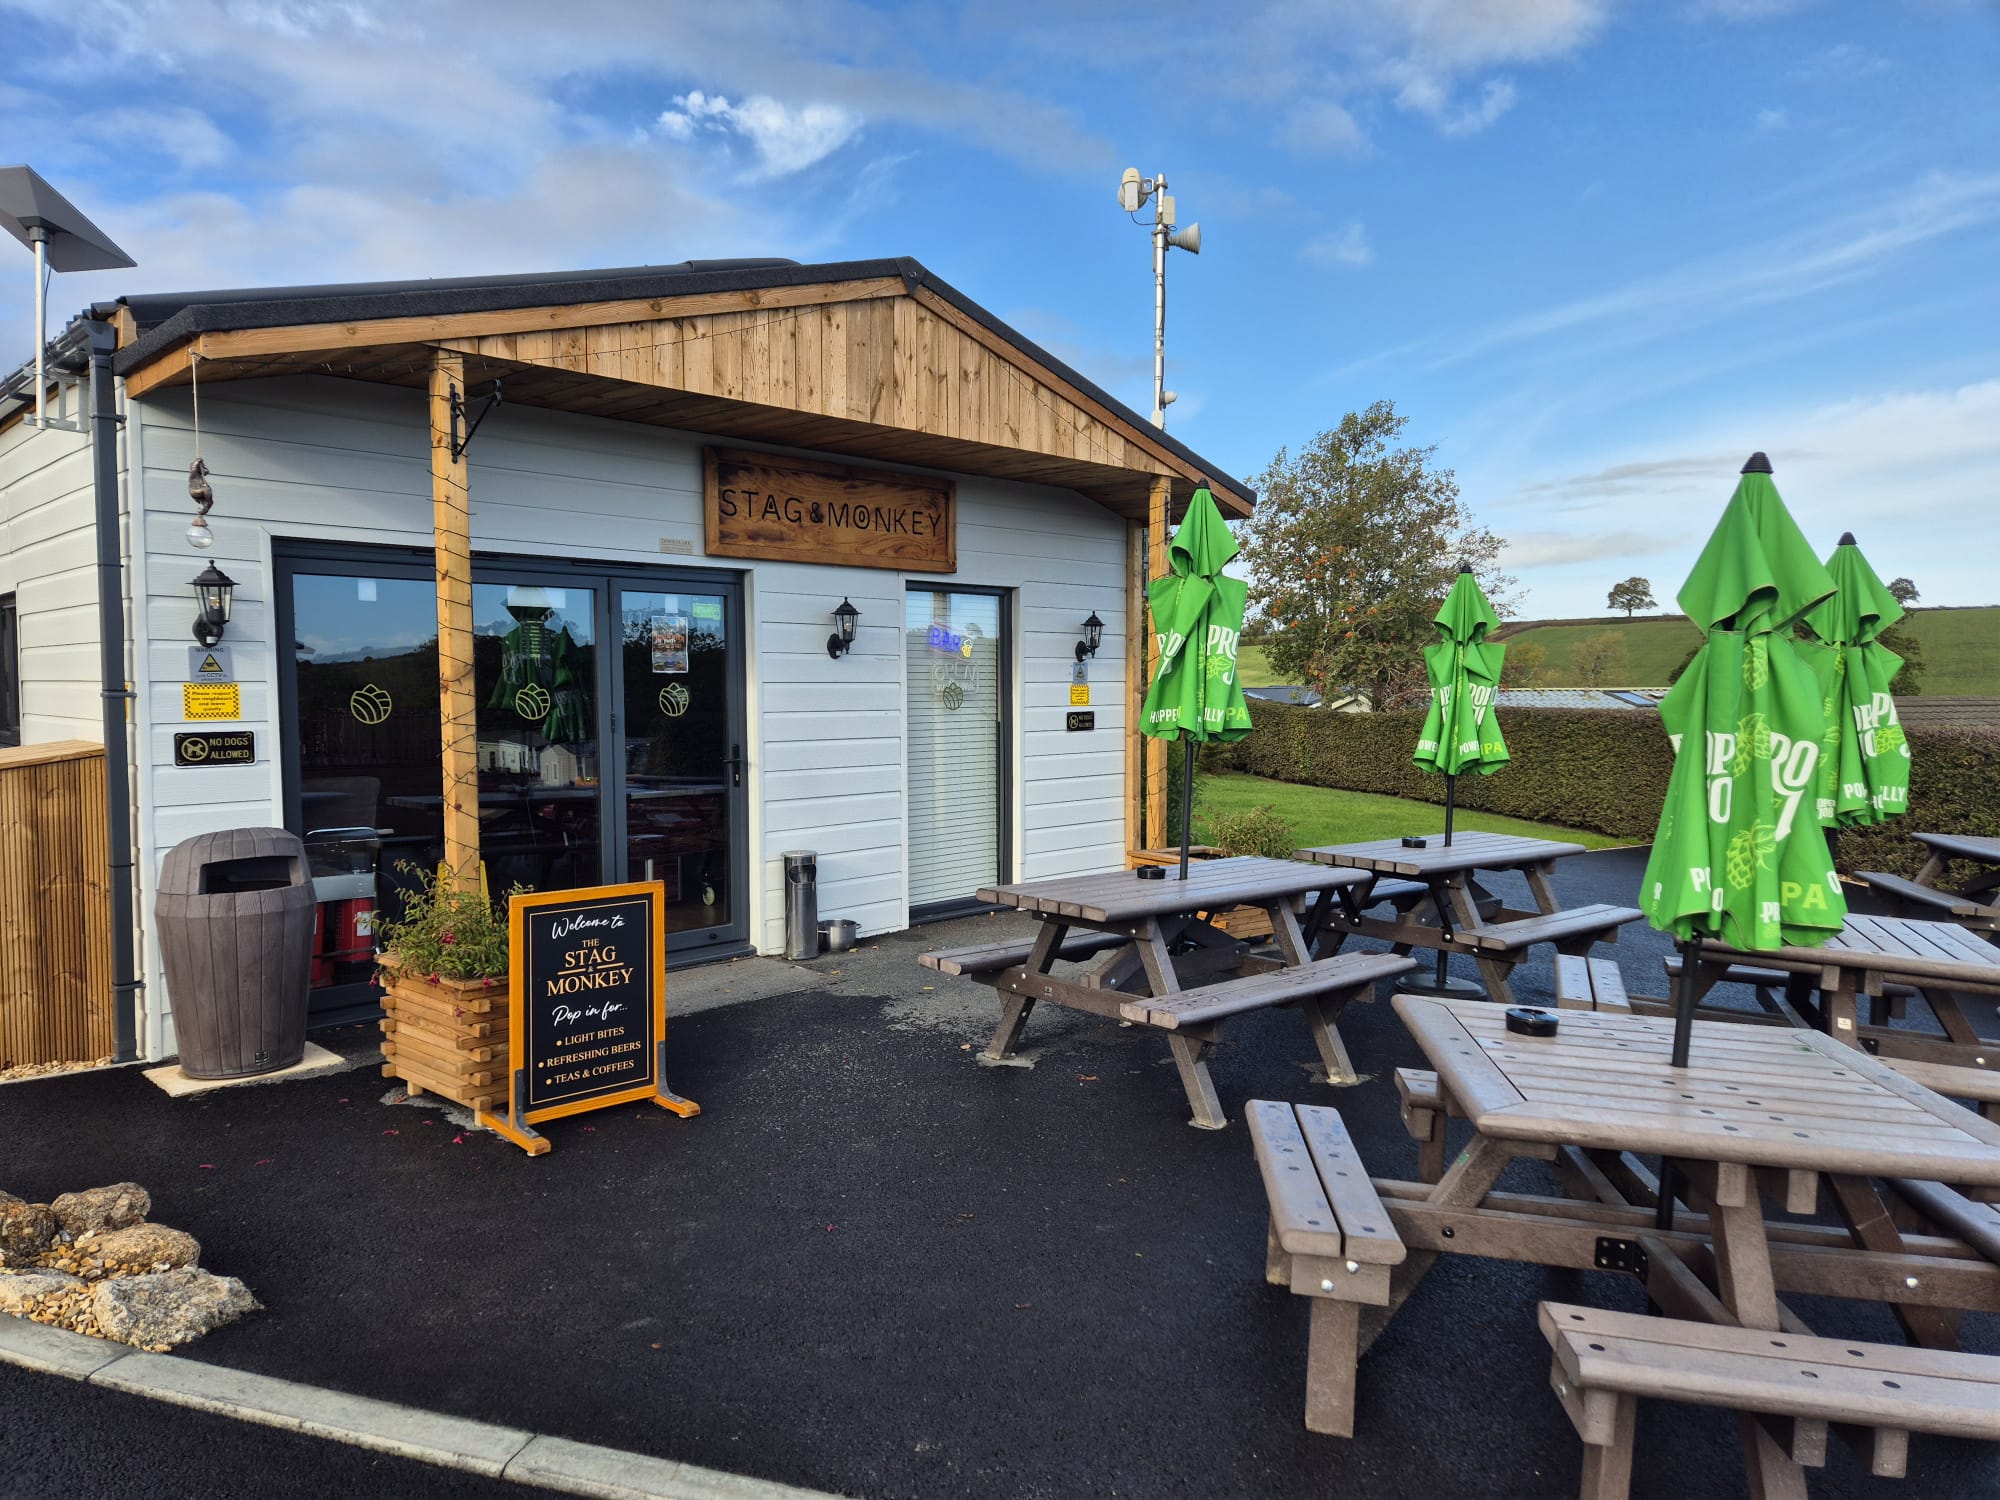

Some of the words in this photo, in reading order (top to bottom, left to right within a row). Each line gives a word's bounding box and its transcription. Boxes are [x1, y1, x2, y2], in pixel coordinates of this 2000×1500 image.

[930, 627, 961, 653] BAR
[209, 738, 222, 747] NO
[224, 737, 249, 746] DOGS
[210, 750, 250, 759] ALLOWED
[551, 914, 609, 940] Welcome
[610, 914, 625, 929] to
[581, 938, 600, 948] THE
[565, 946, 617, 968] STAG
[546, 967, 634, 997] MONKEY
[551, 1005, 581, 1027] Pop
[585, 1004, 600, 1017] in
[565, 1031, 595, 1046] LIGHT
[597, 1026, 625, 1039] BITES
[546, 1047, 609, 1068] REFRESHING
[611, 1040, 642, 1055] BEERS
[554, 1070, 580, 1084] TEAS
[582, 1068, 591, 1079] &
[592, 1059, 635, 1076] COFFEES
